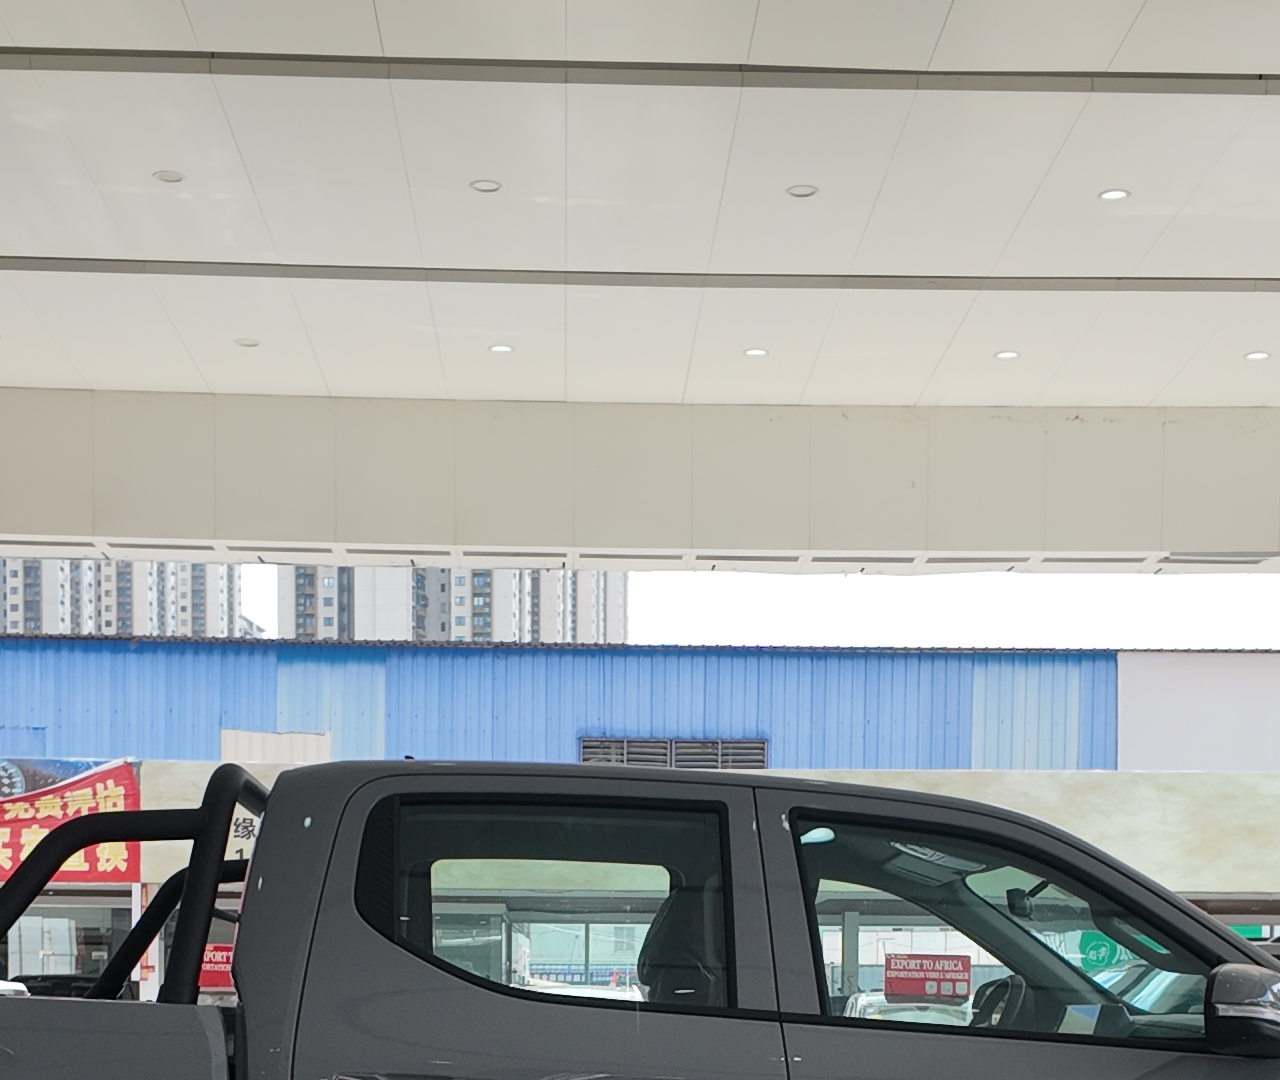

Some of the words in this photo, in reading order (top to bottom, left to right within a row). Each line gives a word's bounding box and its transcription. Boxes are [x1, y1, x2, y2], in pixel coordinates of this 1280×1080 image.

[890, 959, 921, 969] EXPORT
[922, 960, 933, 970] TO
[934, 960, 963, 971] AFRICA
